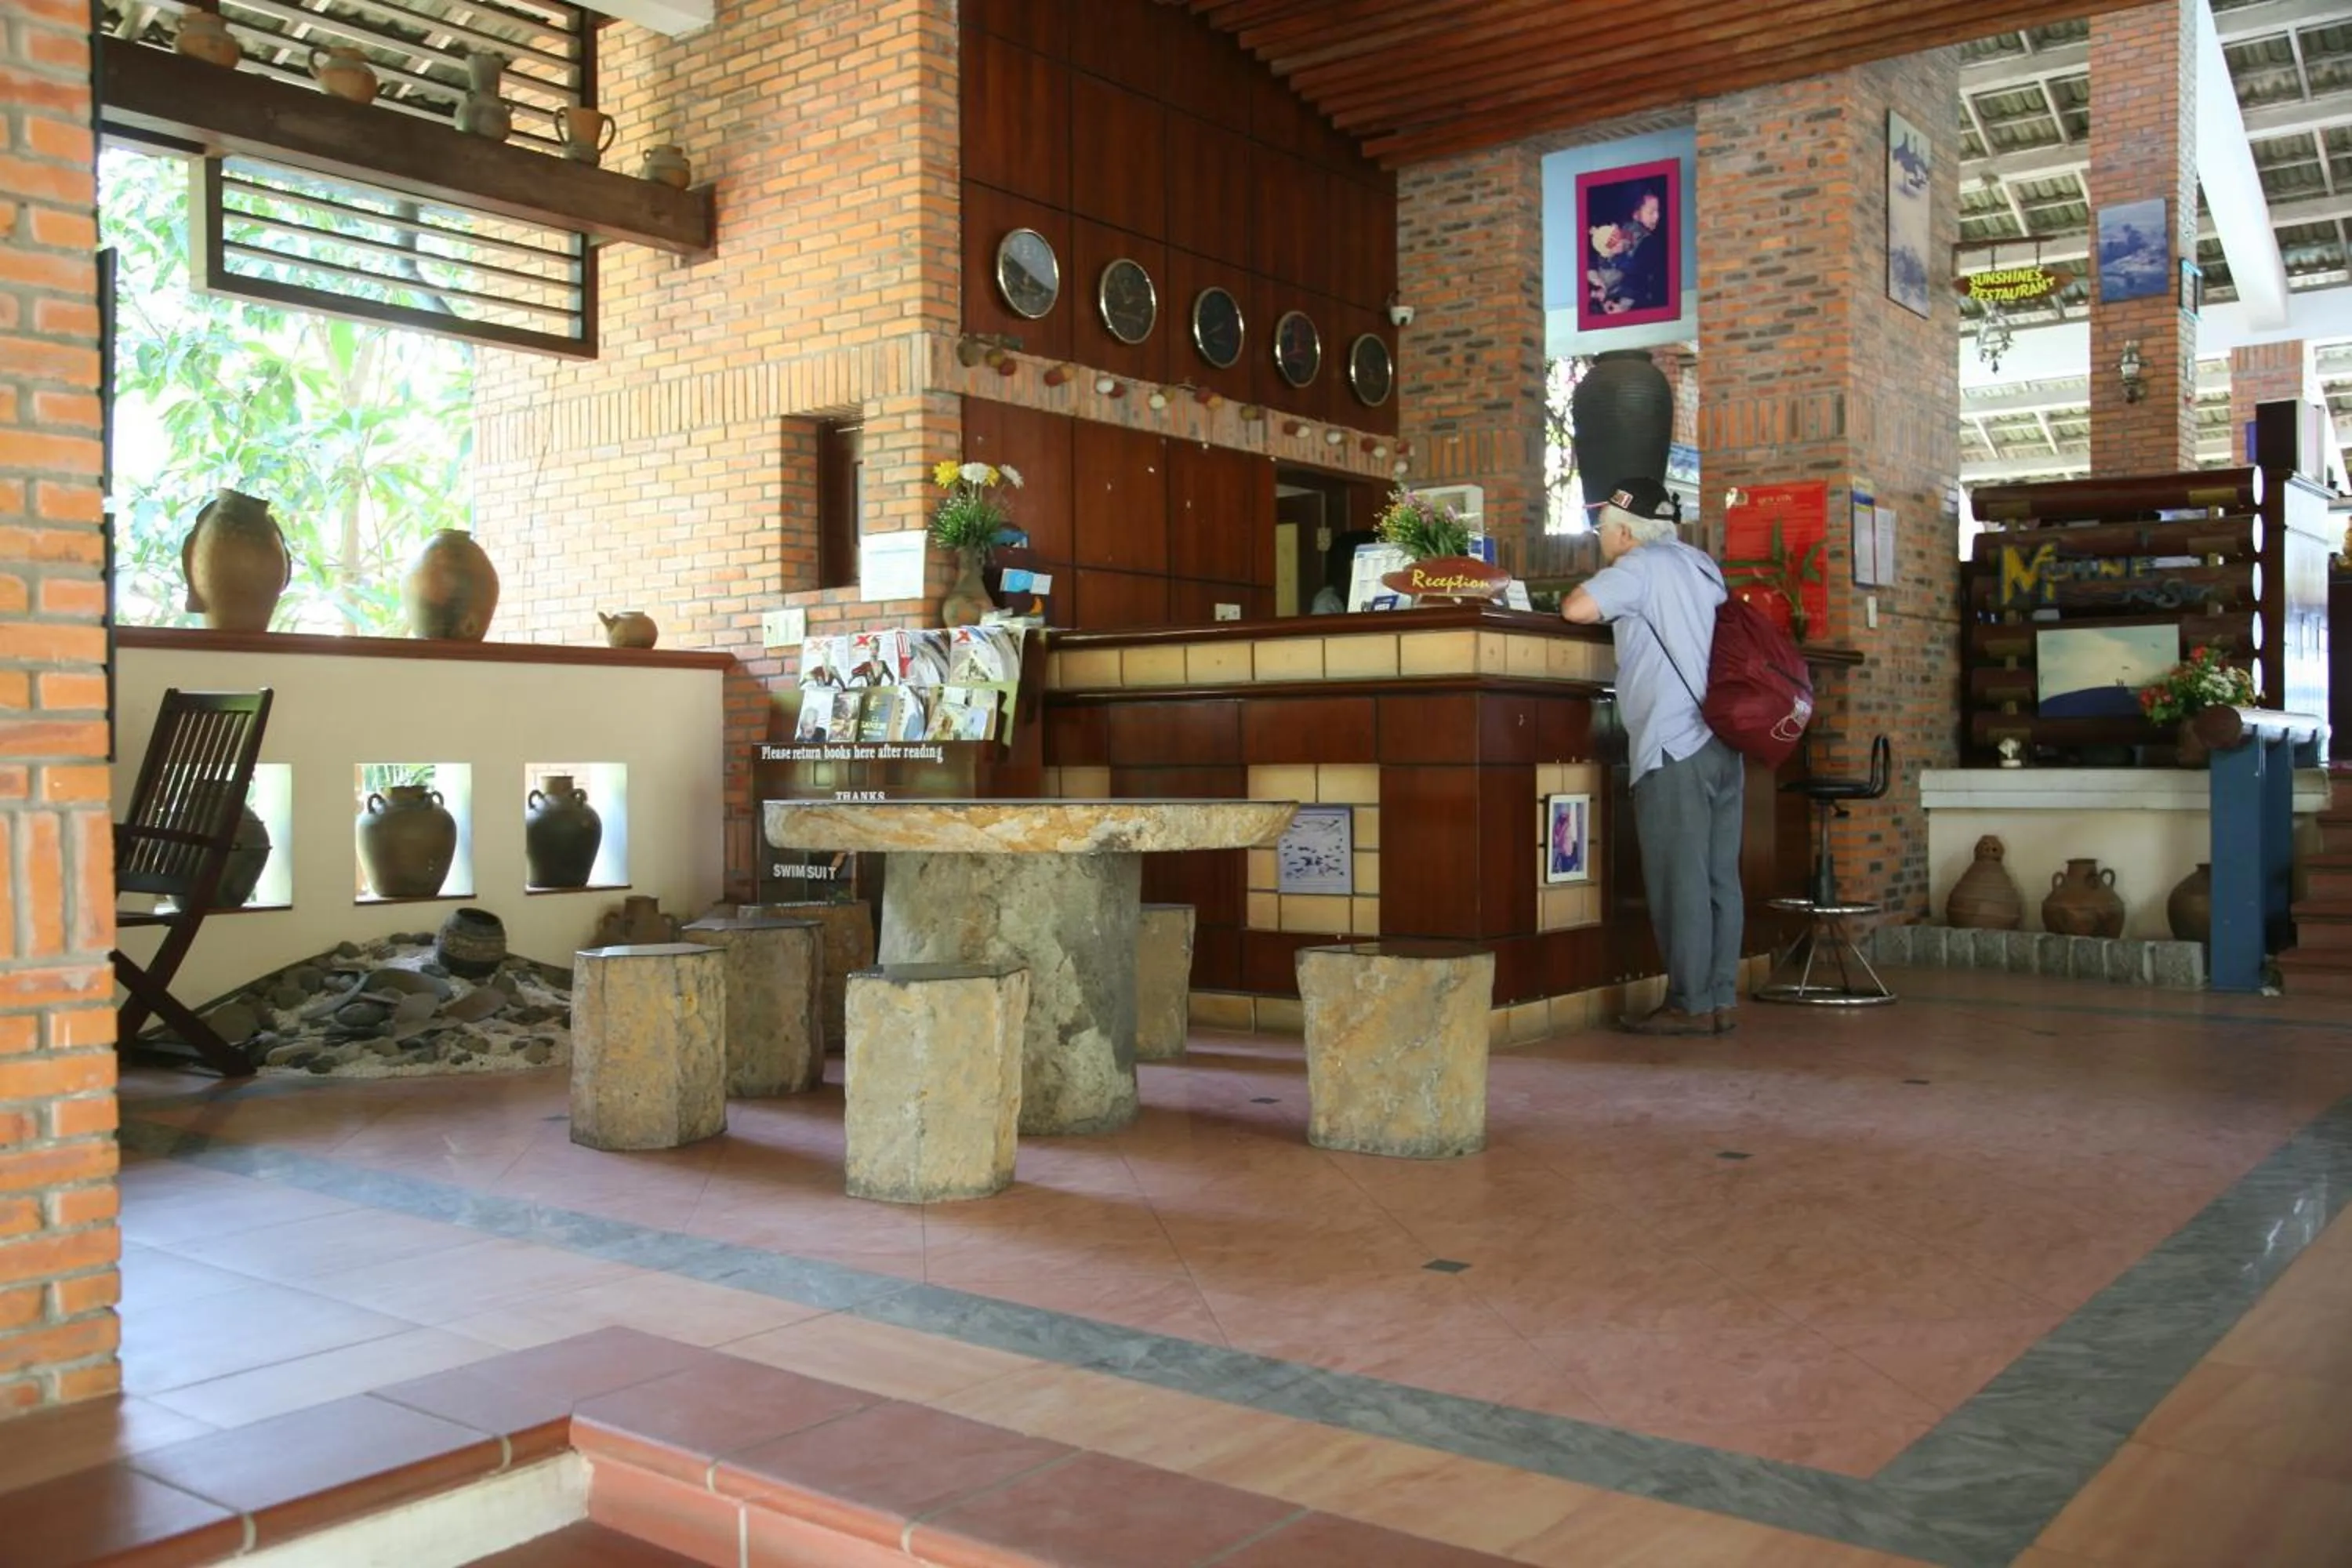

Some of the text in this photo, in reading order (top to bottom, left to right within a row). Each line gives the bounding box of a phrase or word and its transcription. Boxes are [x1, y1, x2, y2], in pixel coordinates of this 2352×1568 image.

[1969, 275, 2055, 301] RESTAURANT
[1412, 568, 1490, 593] Reception
[761, 743, 944, 764] Please return books here after reading
[834, 791, 886, 800] THANKS
